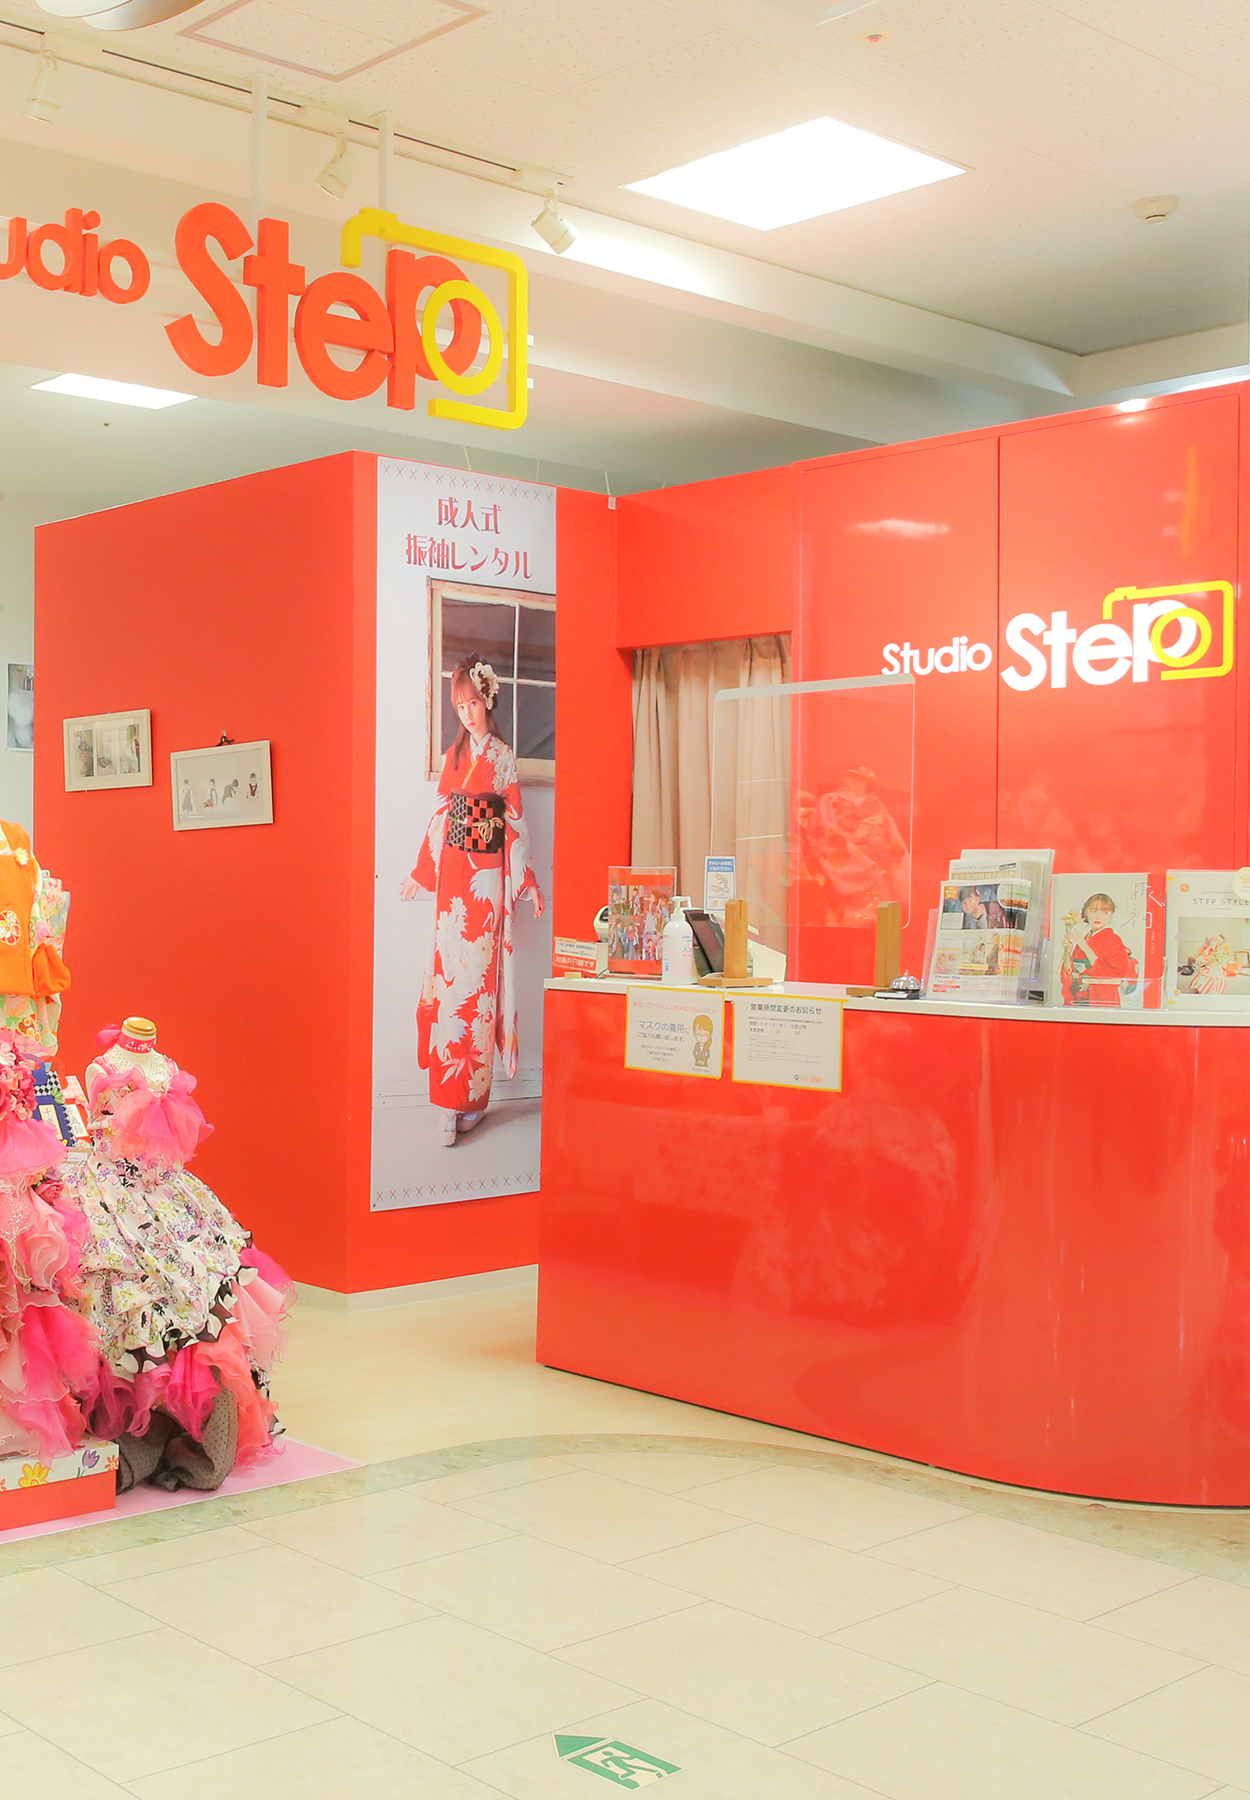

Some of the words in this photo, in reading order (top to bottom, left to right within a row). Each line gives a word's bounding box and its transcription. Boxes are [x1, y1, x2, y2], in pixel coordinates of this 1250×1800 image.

[164, 202, 481, 411] Step
[437, 497, 502, 535] 成人式
[405, 533, 533, 579] 振袖レンタル
[881, 635, 993, 676] Studio
[1000, 599, 1197, 691] Step
[1192, 897, 1217, 905] STEP
[1221, 898, 1249, 906] STYLE
